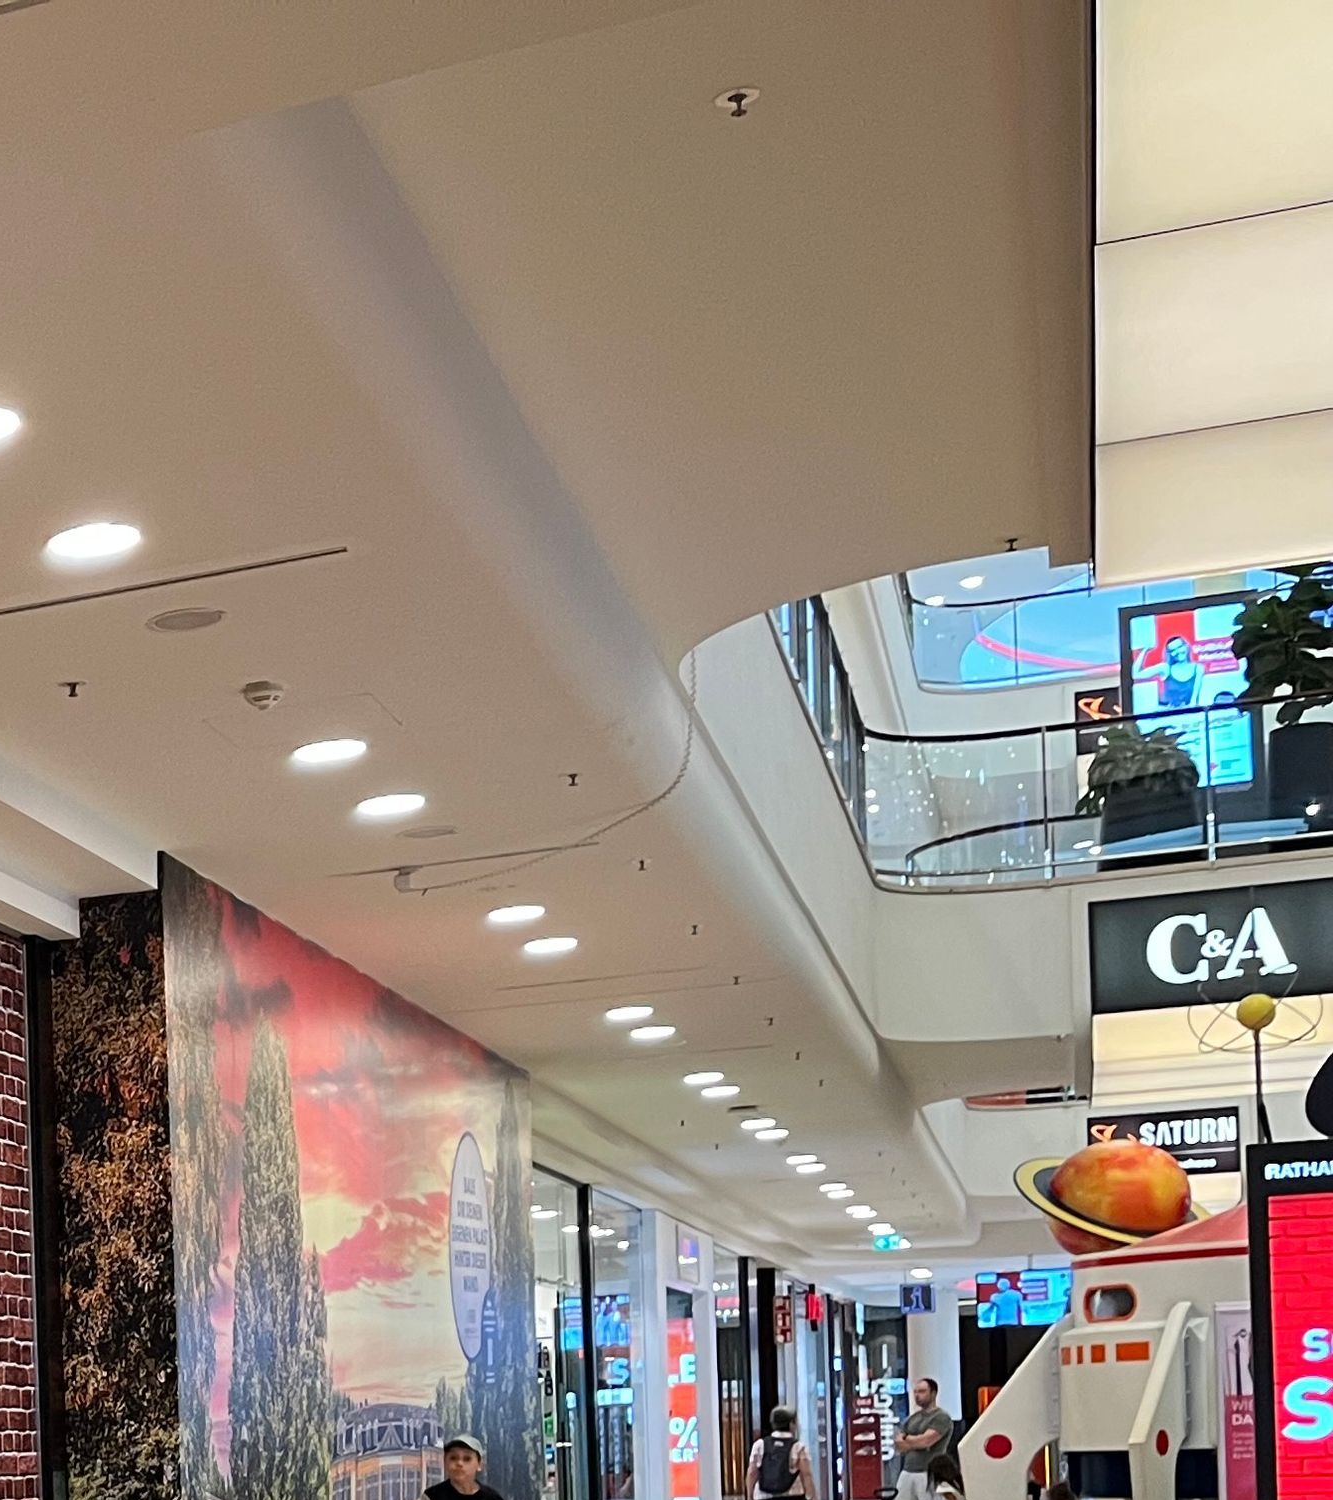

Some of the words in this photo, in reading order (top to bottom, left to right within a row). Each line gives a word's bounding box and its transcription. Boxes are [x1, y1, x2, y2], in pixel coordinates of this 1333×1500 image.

[1146, 906, 1299, 985] C&A
[1139, 1115, 1237, 1147] SATURN
[1264, 1160, 1333, 1181] RATHA
